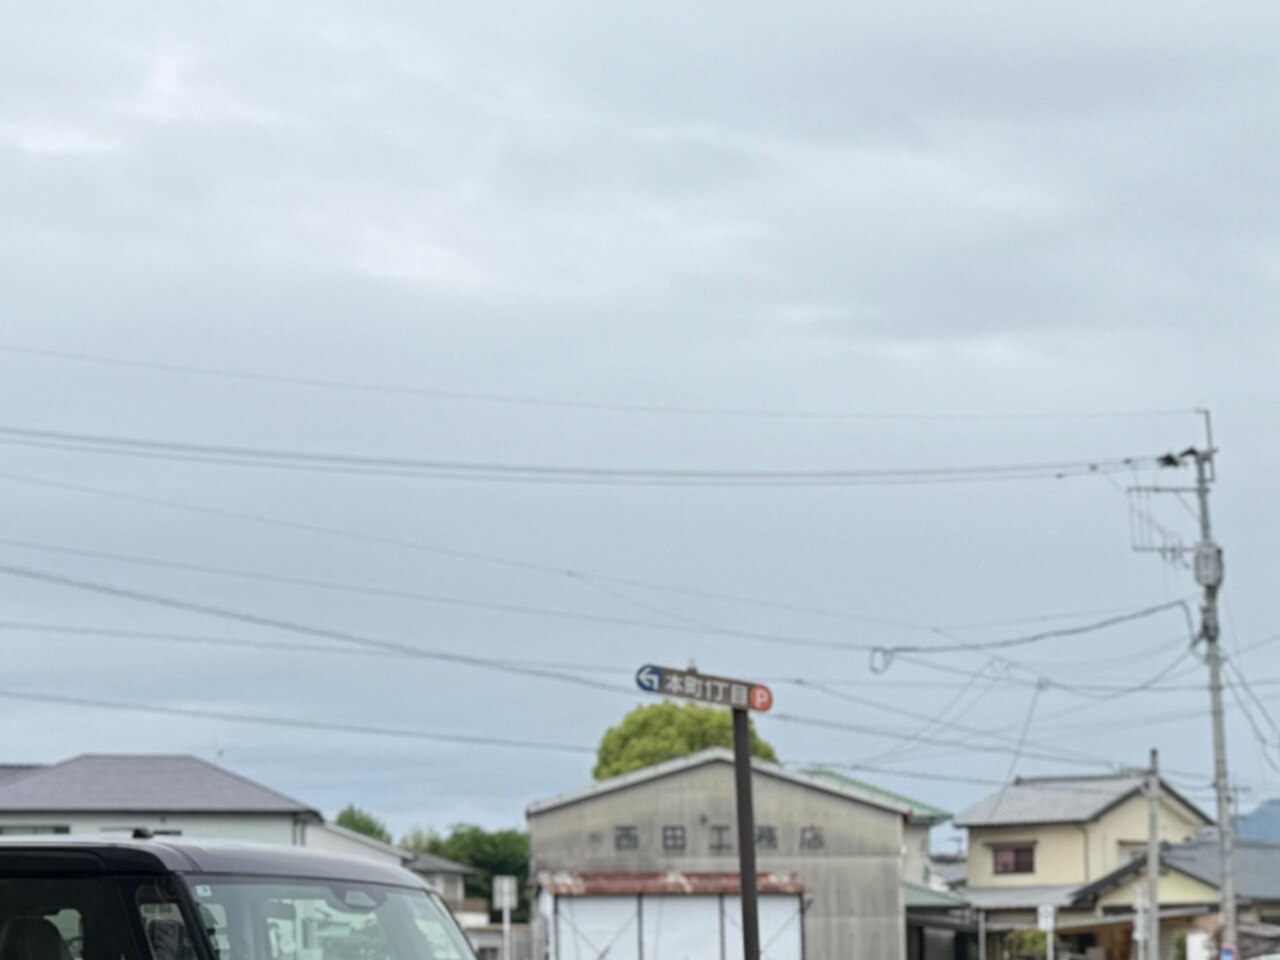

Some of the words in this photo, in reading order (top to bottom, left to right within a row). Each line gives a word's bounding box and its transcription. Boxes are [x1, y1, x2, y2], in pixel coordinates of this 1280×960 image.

[664, 673, 749, 706] 本町1丁目
[755, 690, 769, 708] P
